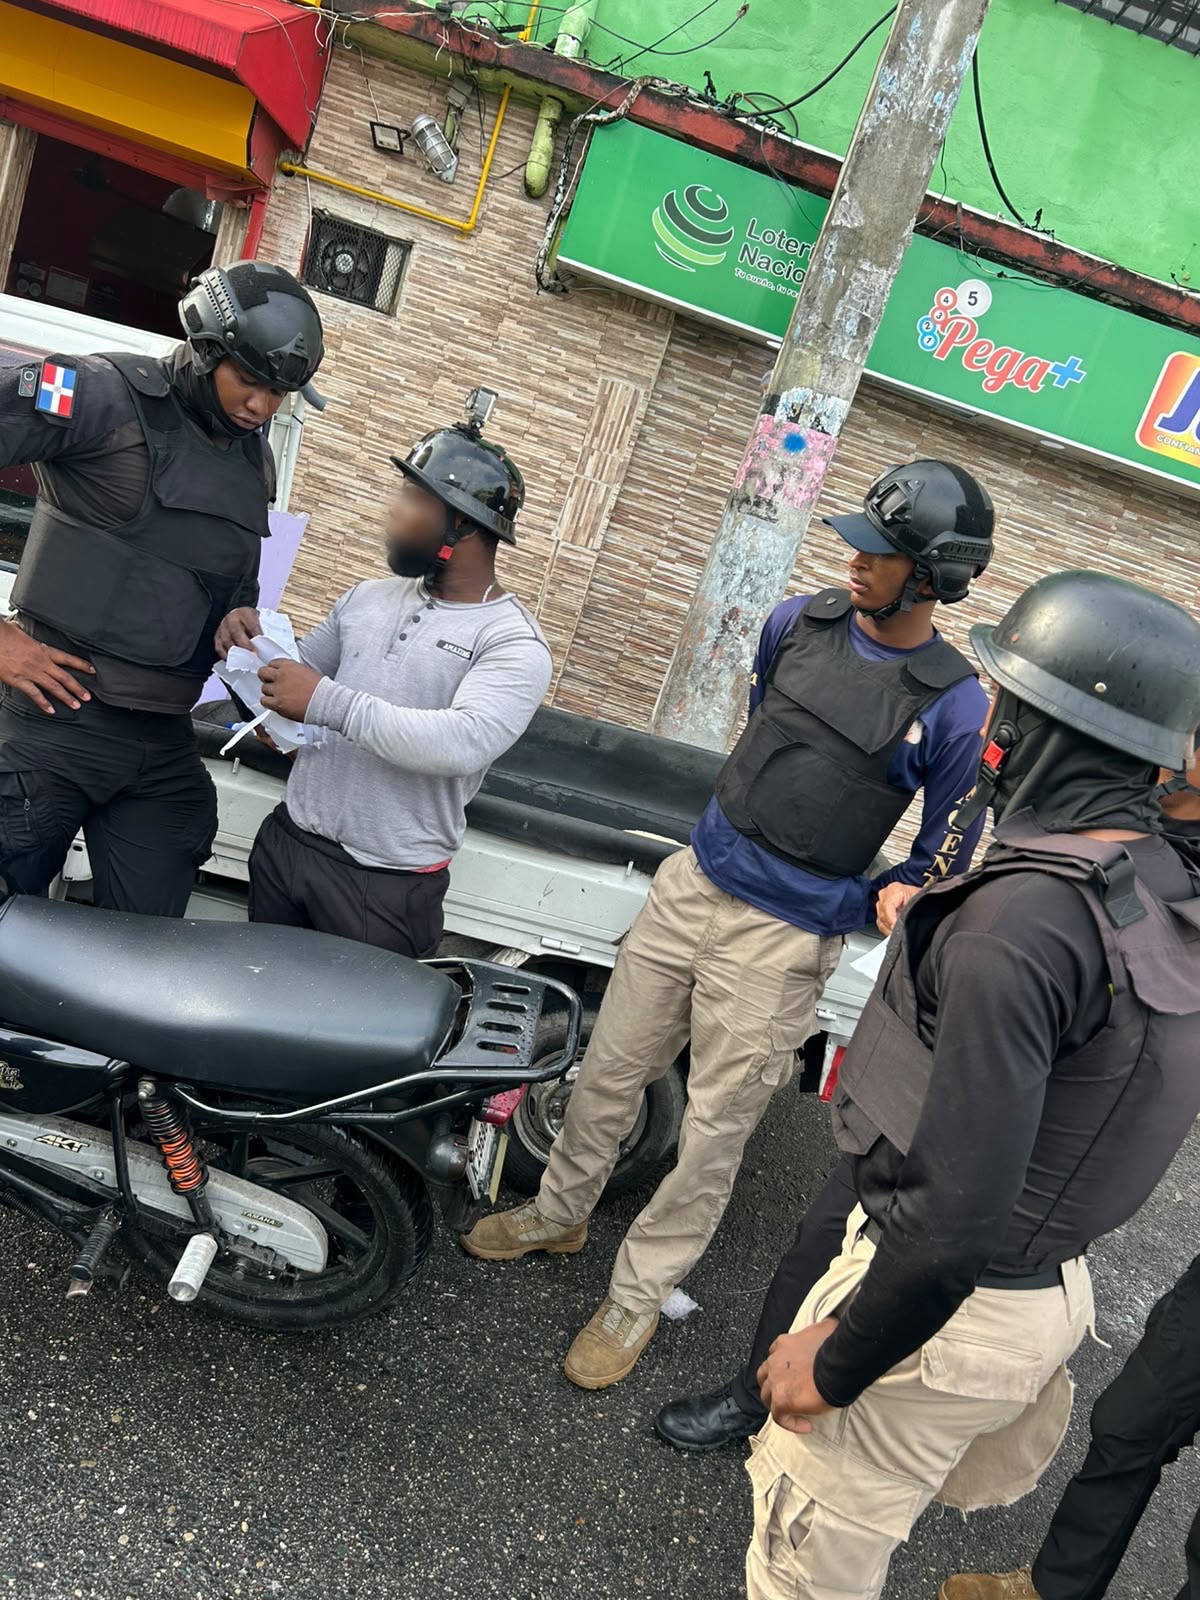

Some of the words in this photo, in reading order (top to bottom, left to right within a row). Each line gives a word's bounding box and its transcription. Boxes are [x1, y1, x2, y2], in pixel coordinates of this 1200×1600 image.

[735, 267, 745, 278] Tu
[776, 284, 787, 294] tu
[967, 291, 978, 306] 5
[34, 1133, 90, 1153] AKT
[241, 1208, 275, 1226] YAMAHA
